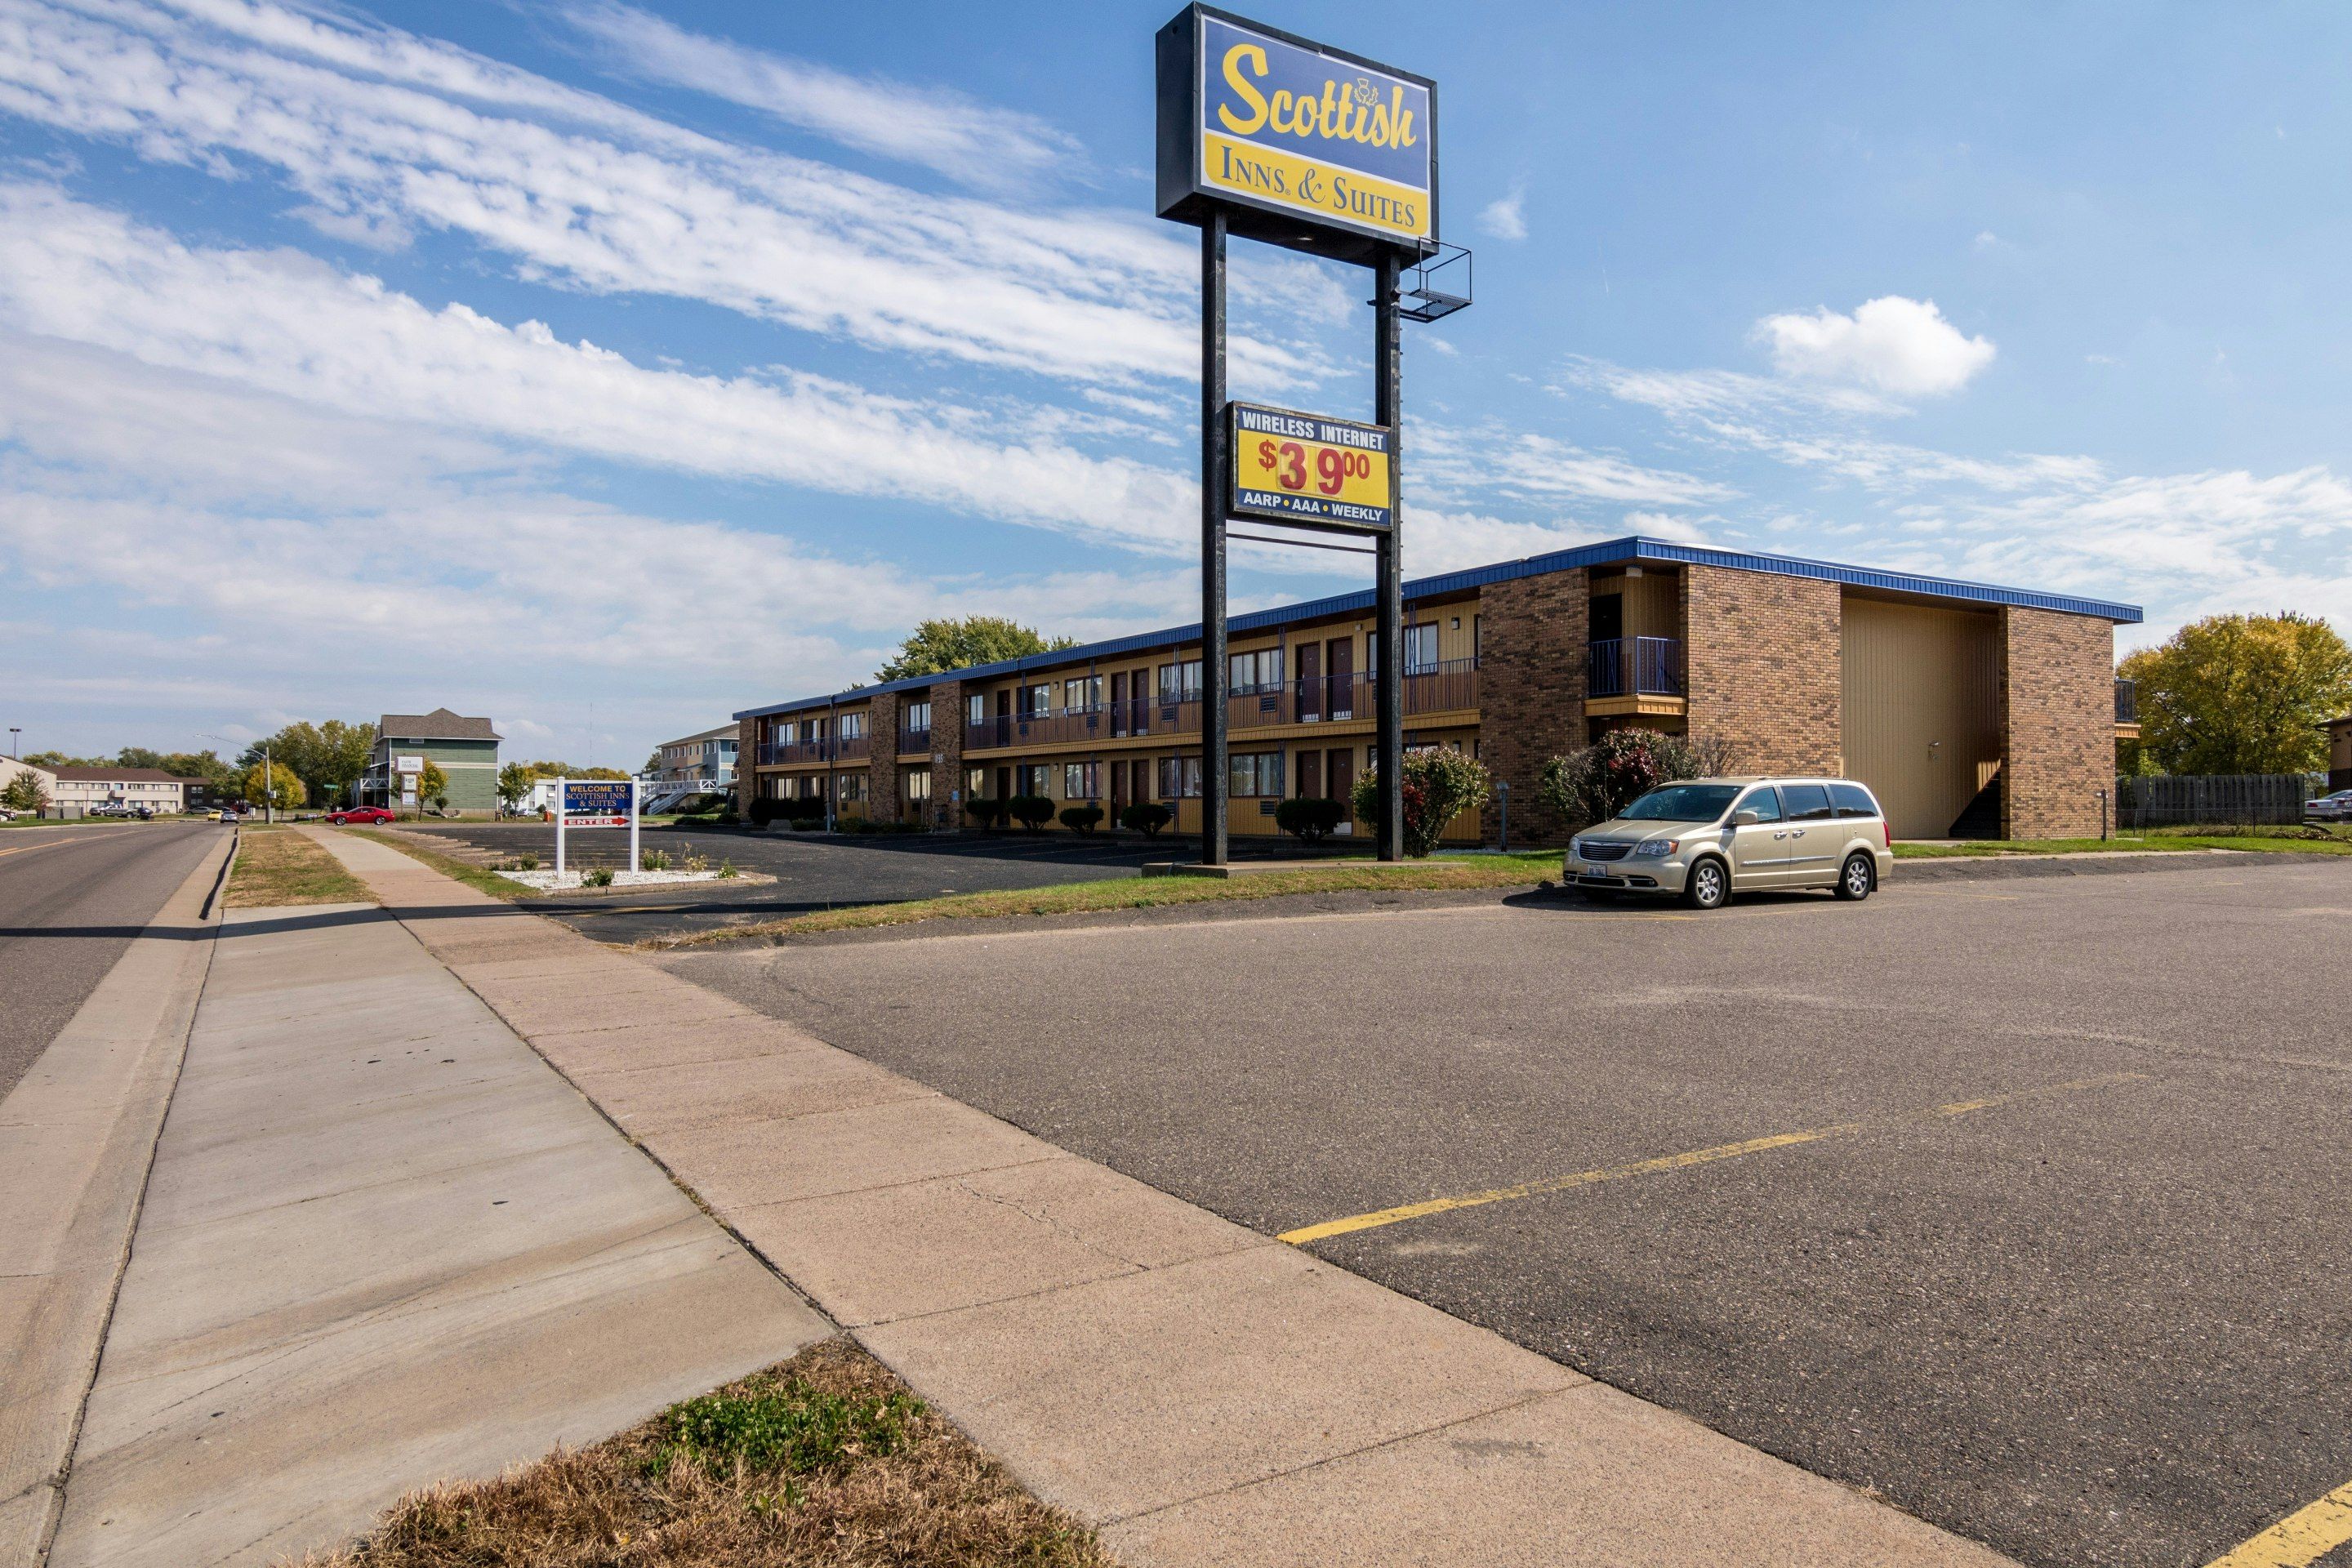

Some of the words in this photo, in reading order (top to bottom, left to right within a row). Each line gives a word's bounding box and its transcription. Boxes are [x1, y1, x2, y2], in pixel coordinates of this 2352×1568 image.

[1218, 43, 1417, 149] Scottish
[1298, 168, 1325, 203] &
[1333, 176, 1414, 228] SUITES
[1242, 411, 1315, 439] WIRELESS
[1321, 425, 1383, 450] INTERNET
[1243, 492, 1281, 507] AARP
[1292, 499, 1320, 513] AAA
[1331, 503, 1383, 521] WEEKLY
